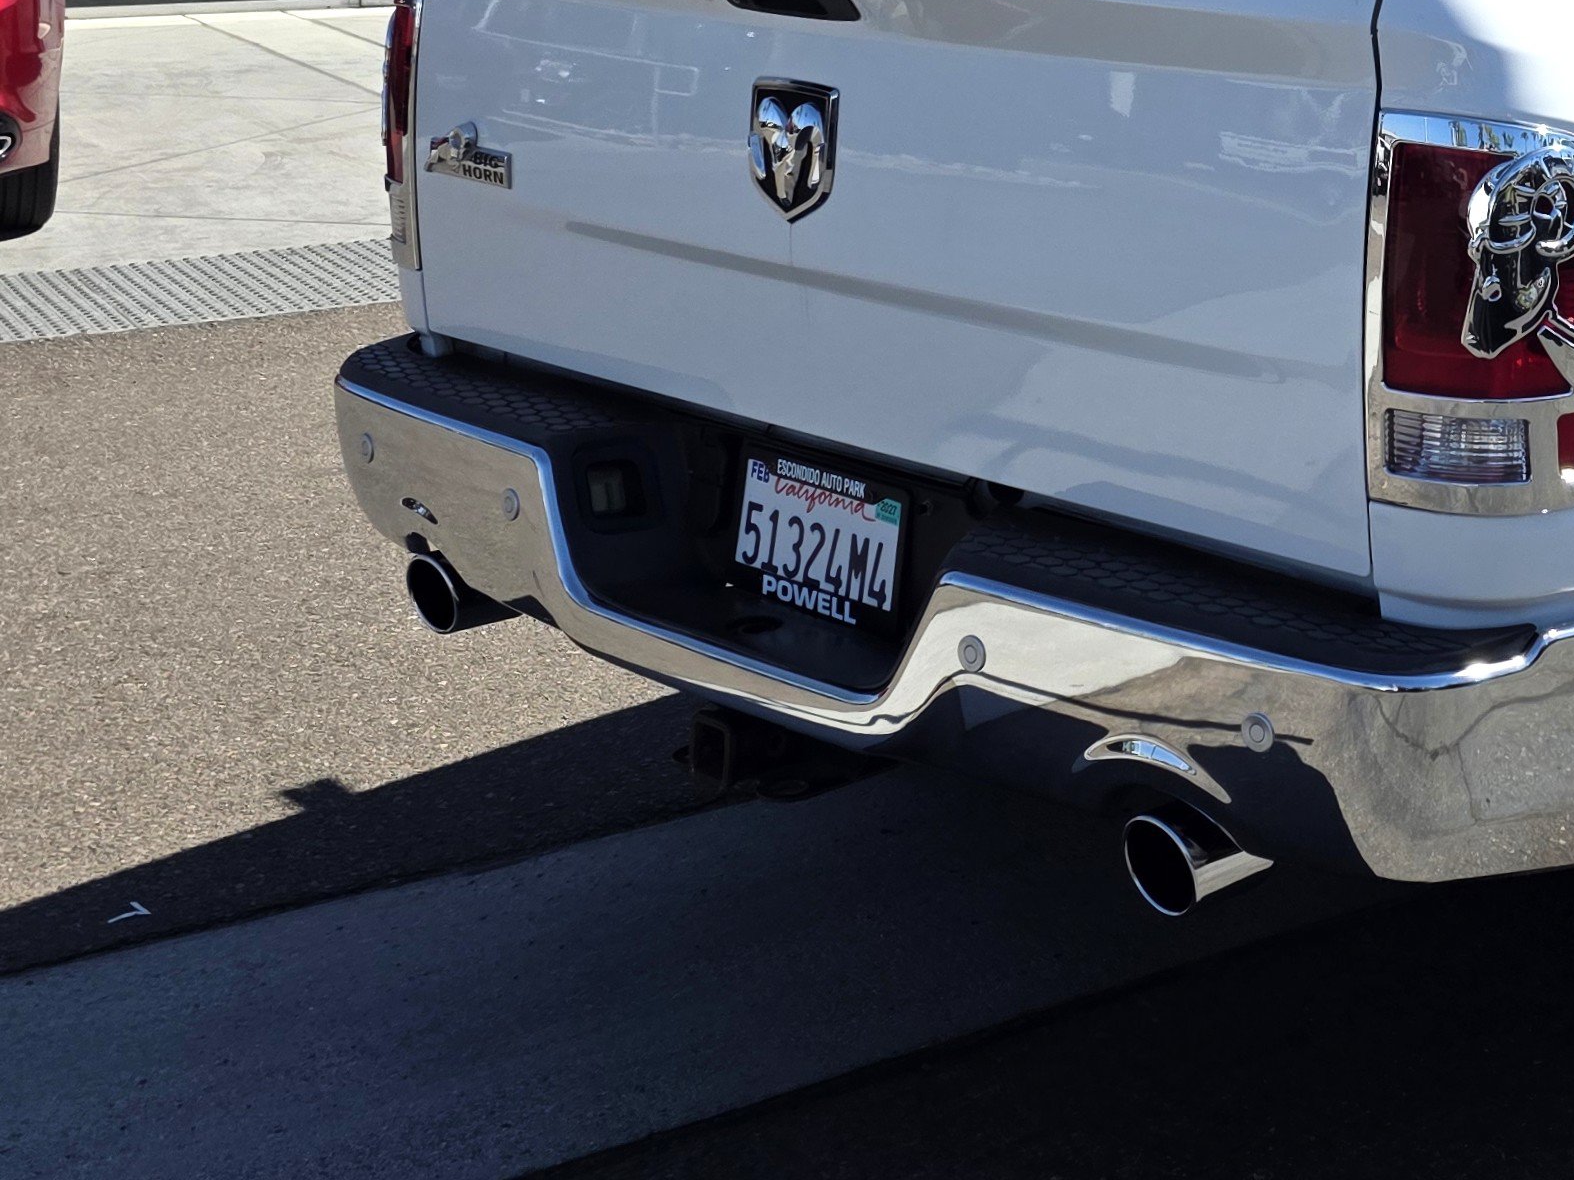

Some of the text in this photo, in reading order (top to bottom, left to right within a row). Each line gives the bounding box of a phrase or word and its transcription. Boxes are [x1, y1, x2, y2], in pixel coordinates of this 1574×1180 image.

[462, 164, 504, 185] HORN
[473, 151, 505, 169] BIG
[775, 476, 876, 522] California
[777, 459, 866, 499] ESCONDIDO AUTO PARK
[742, 501, 887, 609] 51324M4
[762, 574, 856, 625] POWELL
